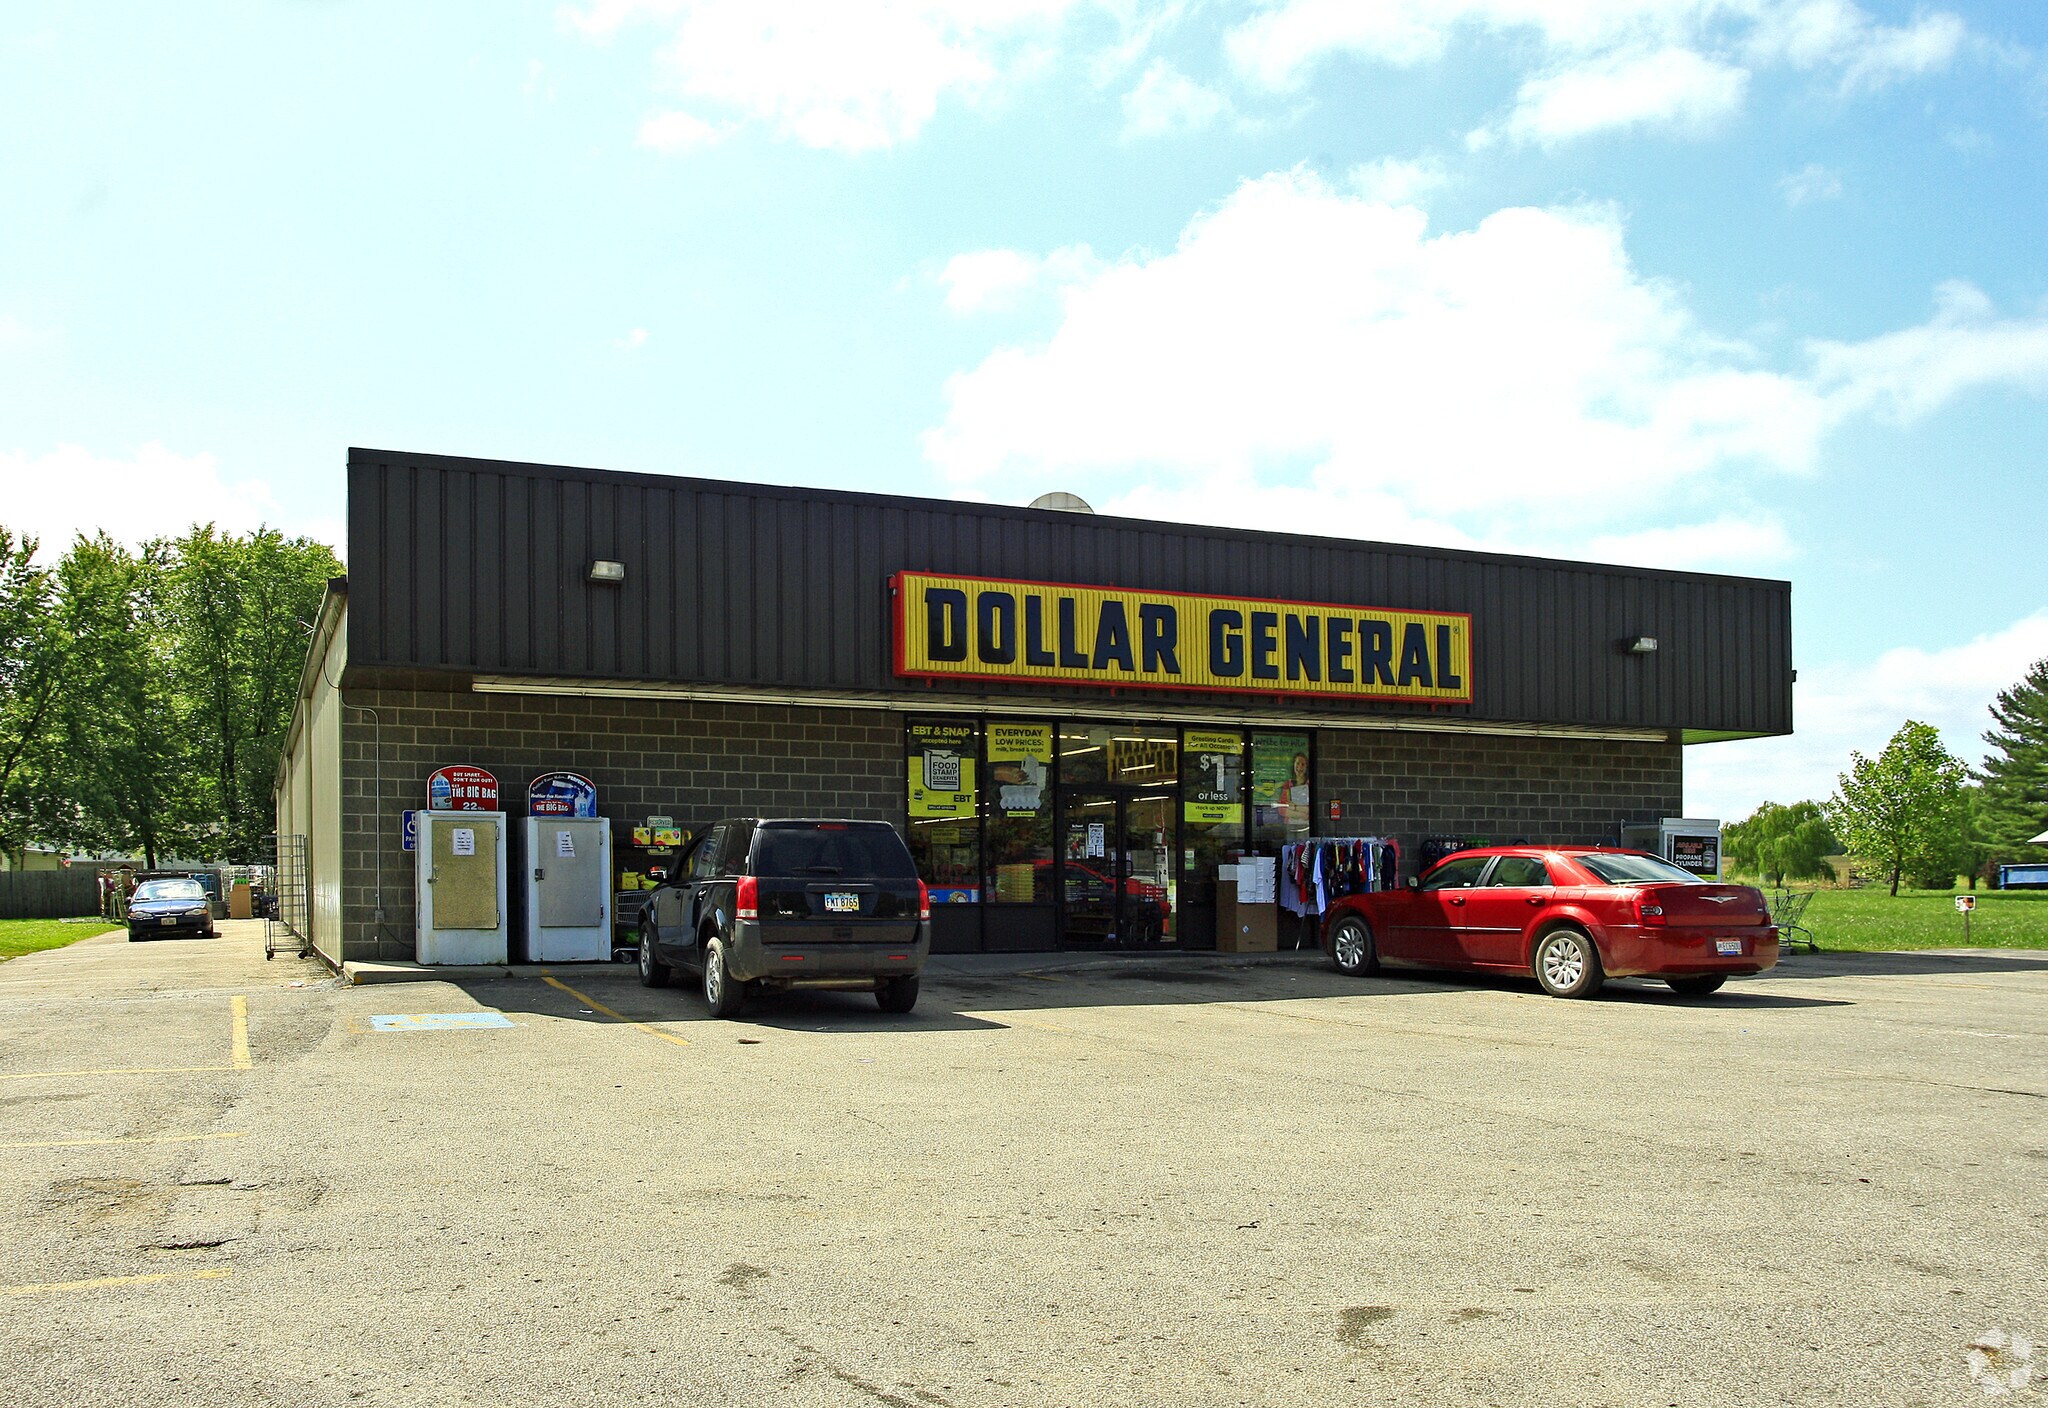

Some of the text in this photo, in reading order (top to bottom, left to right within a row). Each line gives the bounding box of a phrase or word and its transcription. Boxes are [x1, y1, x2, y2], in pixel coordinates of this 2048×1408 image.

[924, 587, 1461, 689] DOLLAR GENERAL
[912, 726, 970, 737] EBT & SNAP
[995, 729, 1043, 737] EVERYDAY
[1191, 735, 1217, 743] Greeting
[1200, 754, 1224, 791] $1
[452, 786, 496, 799] THE BIG BAG
[1210, 791, 1228, 801] less
[546, 803, 557, 812] BIG
[558, 804, 569, 812] BAG
